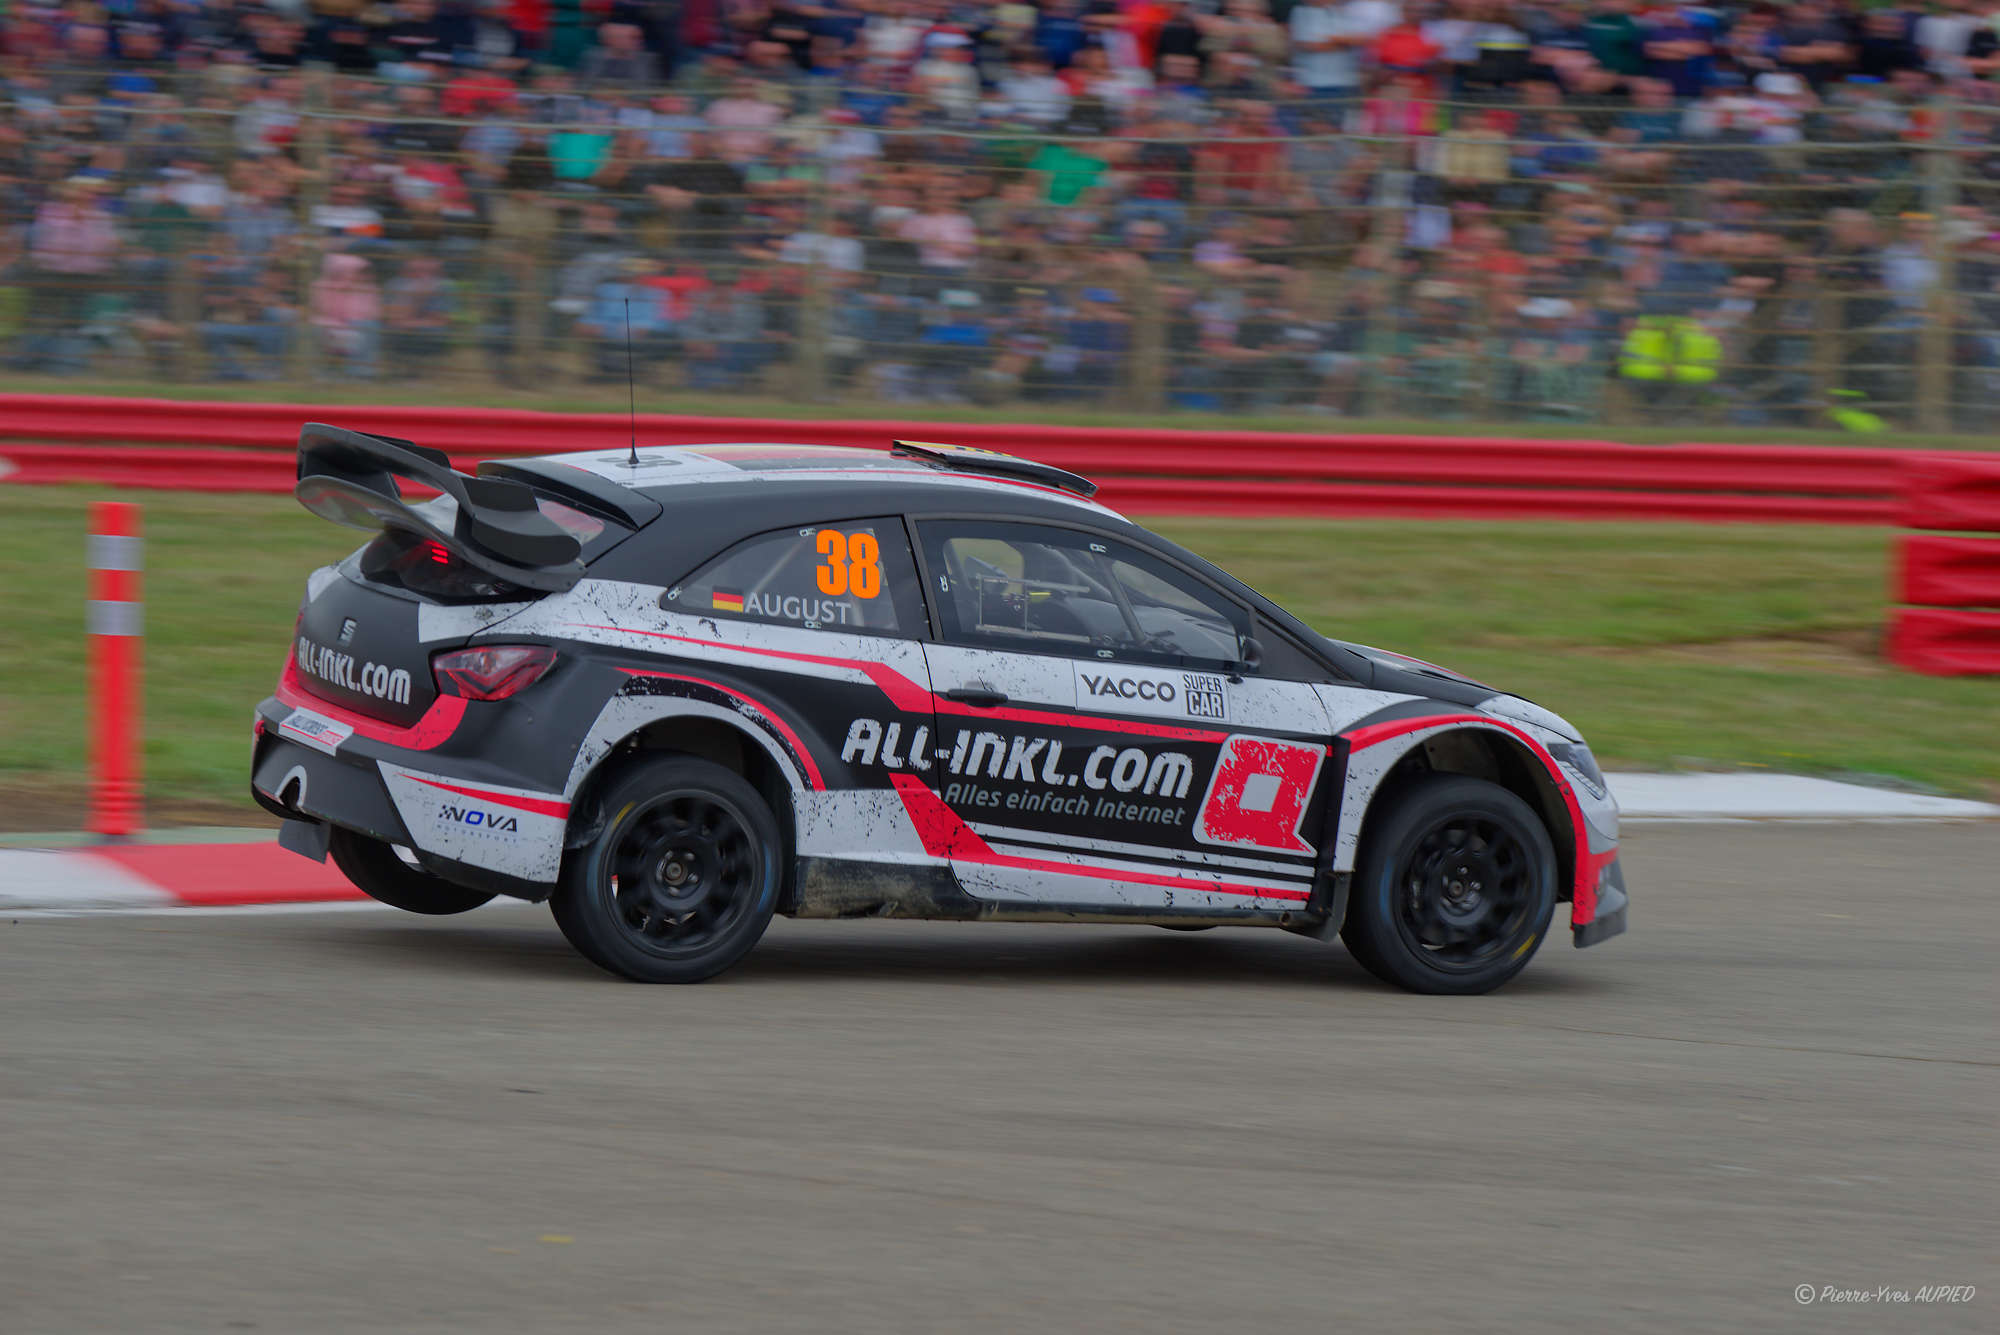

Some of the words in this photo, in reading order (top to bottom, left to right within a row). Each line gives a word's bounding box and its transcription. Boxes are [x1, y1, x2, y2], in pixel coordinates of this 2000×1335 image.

[816, 529, 881, 599] 38
[744, 591, 852, 625] AUGUST
[1080, 673, 1176, 702] YACCO
[1183, 673, 1223, 692] SUPER
[1188, 691, 1224, 718] CAR
[841, 718, 1194, 799] ALL-INKL.COM
[445, 805, 518, 832] NOVA
[944, 783, 1002, 808] Alles
[1005, 788, 1090, 817] einfach
[1094, 793, 1186, 826] Internet
